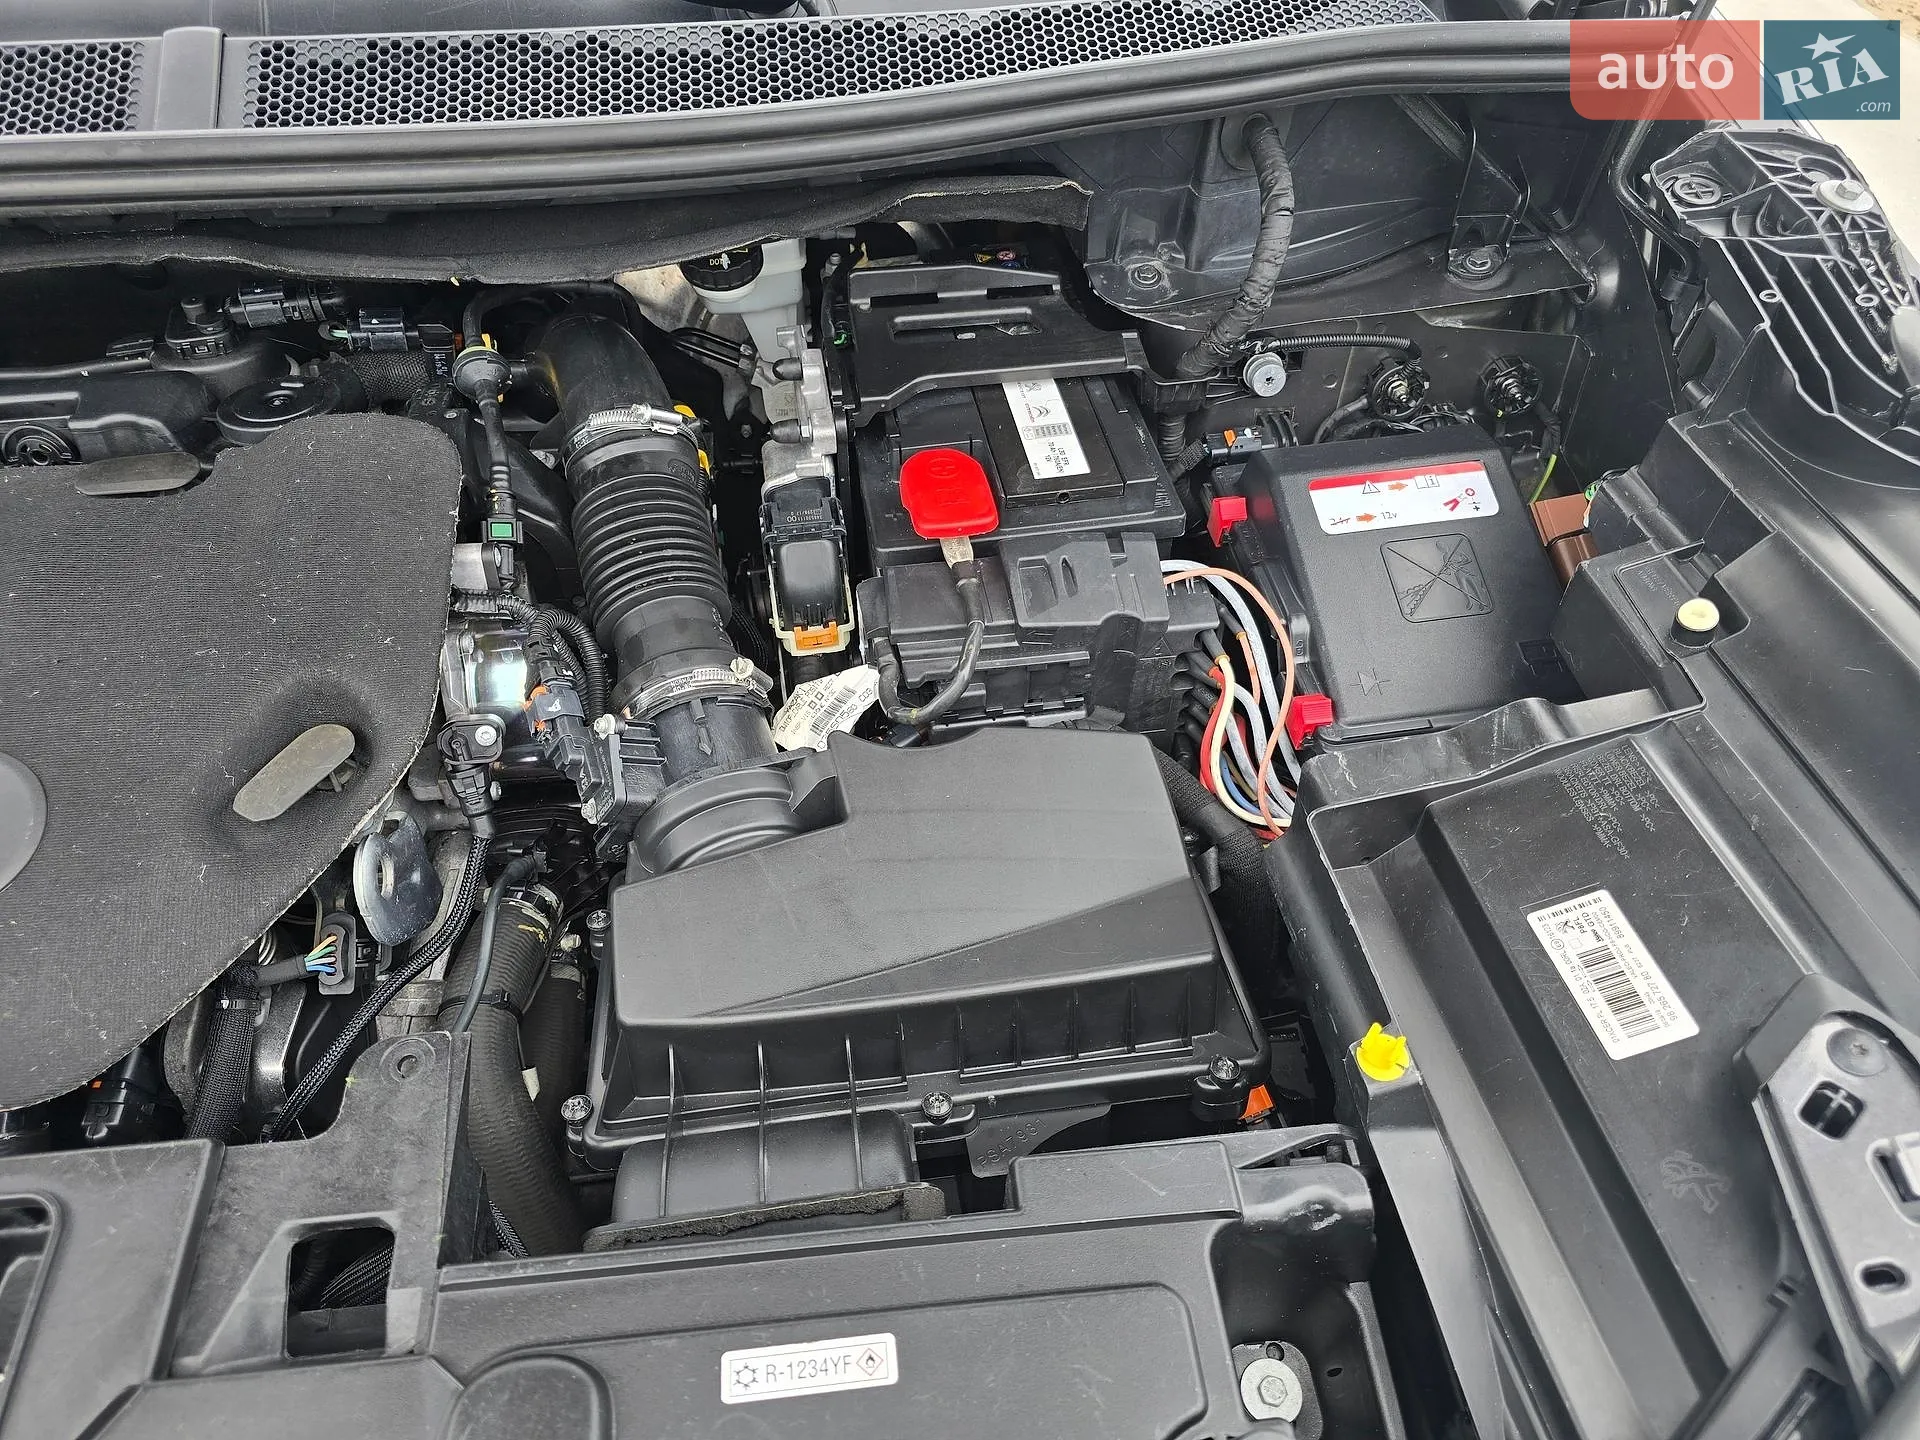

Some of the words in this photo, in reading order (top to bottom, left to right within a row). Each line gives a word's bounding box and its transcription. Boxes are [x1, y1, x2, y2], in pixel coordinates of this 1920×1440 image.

[784, 686, 804, 713] YAZAKI
[1580, 911, 1595, 927] GTD
[765, 1354, 852, 1383] R-1234YF
